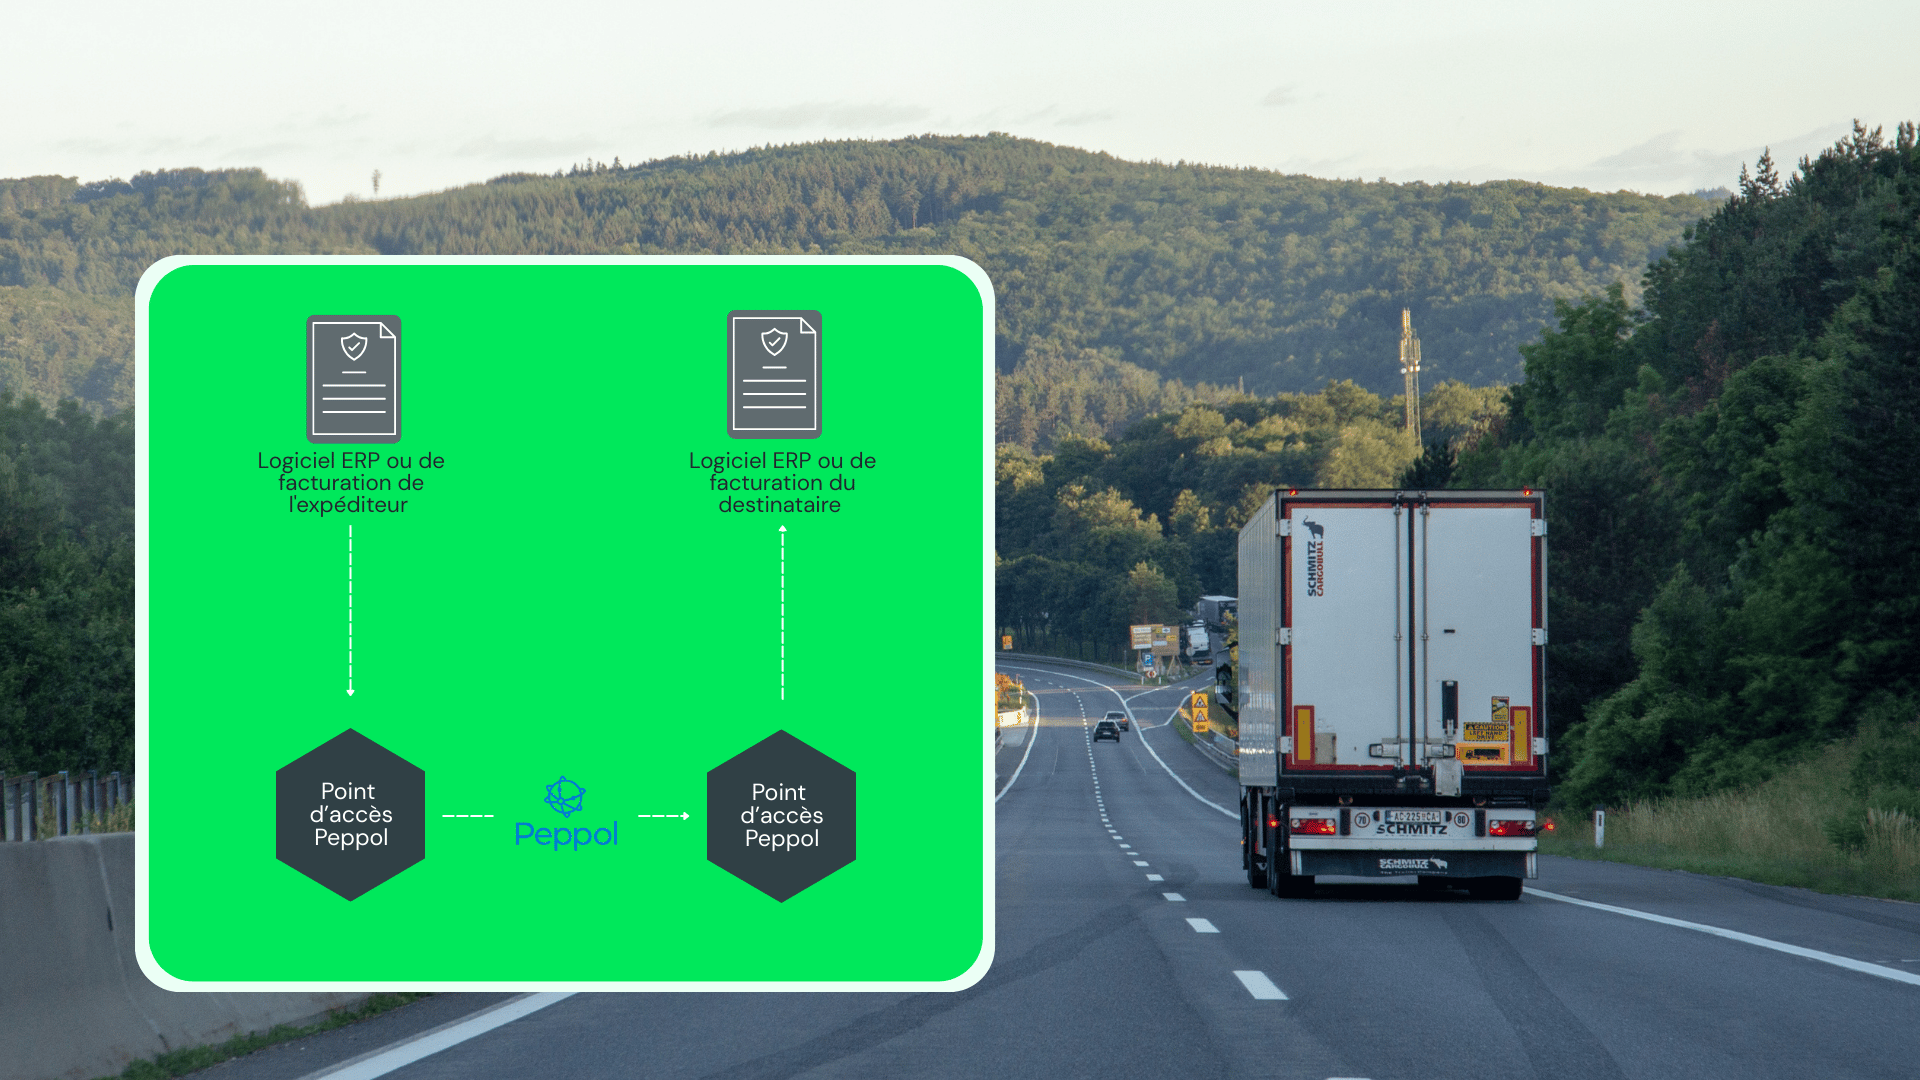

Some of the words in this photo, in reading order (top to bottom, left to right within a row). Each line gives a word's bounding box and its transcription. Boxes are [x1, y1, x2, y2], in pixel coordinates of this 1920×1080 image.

[1307, 541, 1316, 597] SCHMITZ
[1358, 816, 1367, 824] 70
[1457, 815, 1466, 824] 80
[1376, 824, 1448, 835] SCHMITZ
